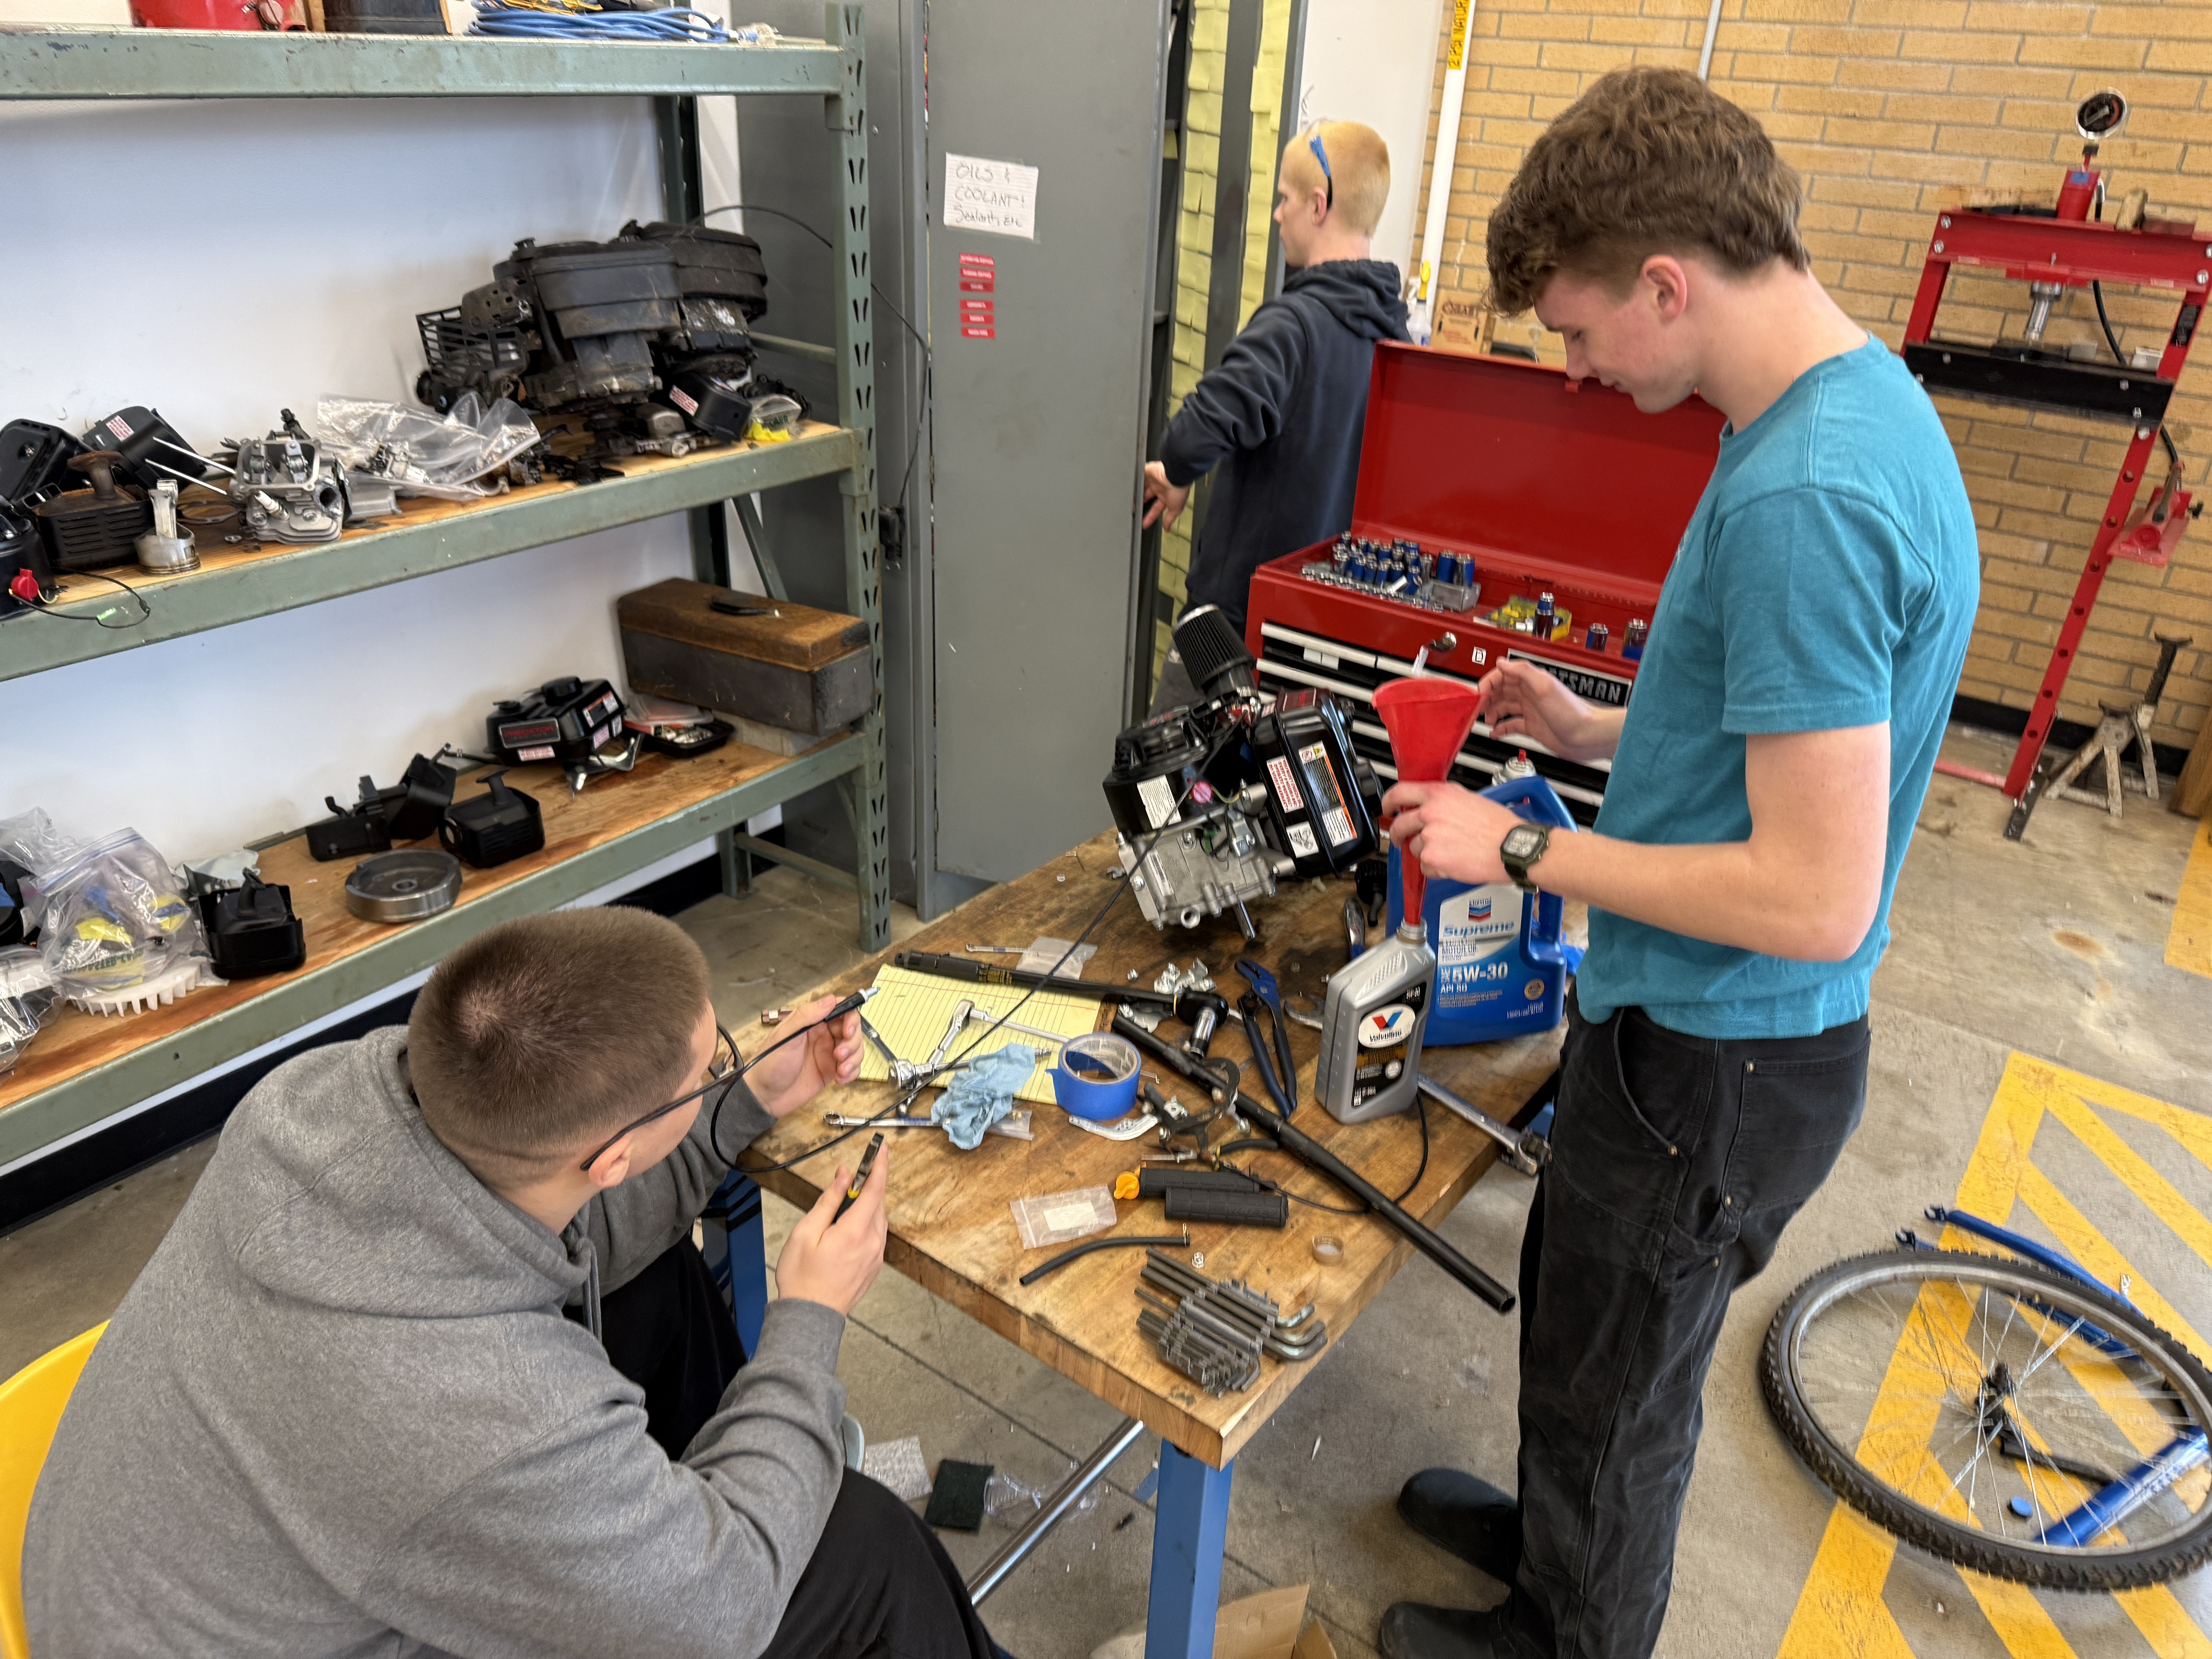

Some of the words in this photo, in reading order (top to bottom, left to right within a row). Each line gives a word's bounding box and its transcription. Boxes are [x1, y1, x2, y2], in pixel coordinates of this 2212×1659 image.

[956, 161, 993, 182] OILS
[1475, 648, 1483, 662] D
[1537, 664, 1621, 704] TSMAN
[1443, 921, 1514, 939] Supreme
[1453, 961, 1508, 984] 5W-30
[1440, 983, 1454, 993] API
[1369, 1029, 1402, 1043] Valvoline
